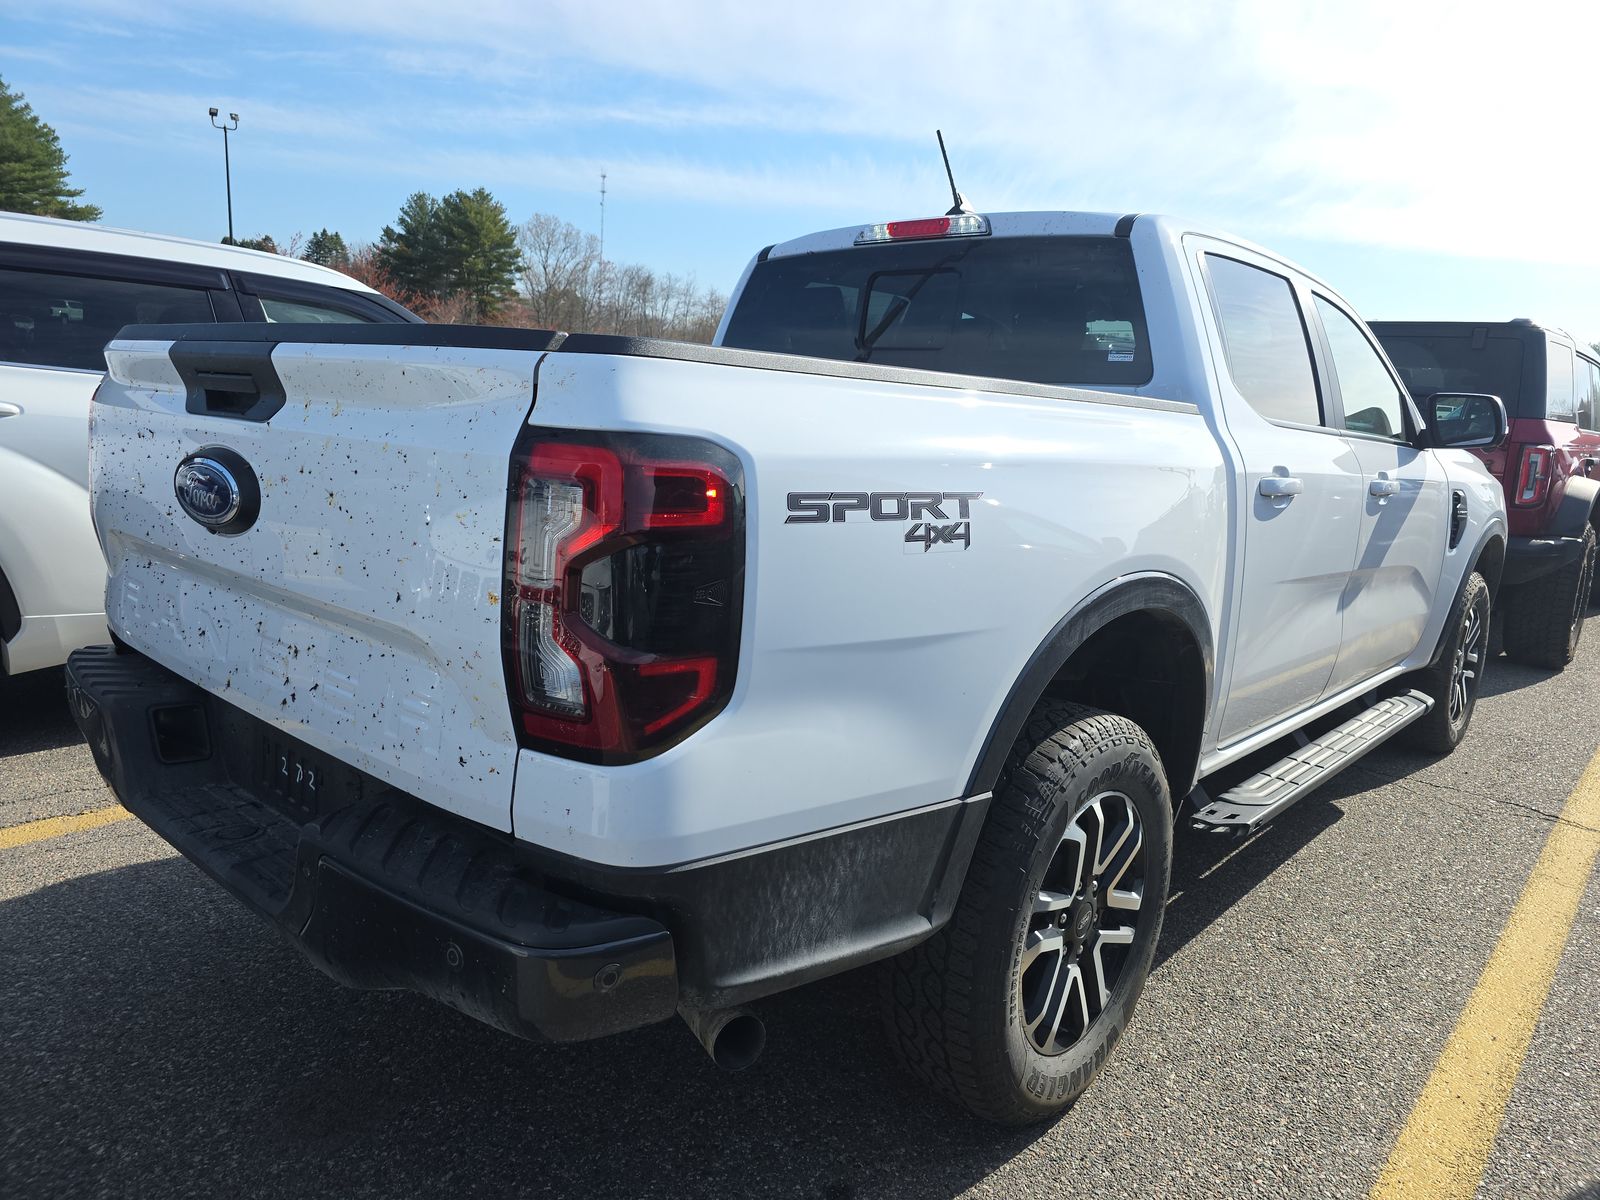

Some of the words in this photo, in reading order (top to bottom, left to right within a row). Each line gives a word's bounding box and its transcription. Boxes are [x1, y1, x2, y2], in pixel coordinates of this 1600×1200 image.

[184, 470, 219, 509] Ford
[785, 491, 984, 524] SPORT
[121, 577, 442, 754] RANGER
[1075, 759, 1162, 812] GOODYEAR
[1027, 1024, 1120, 1101] WRANGLER
